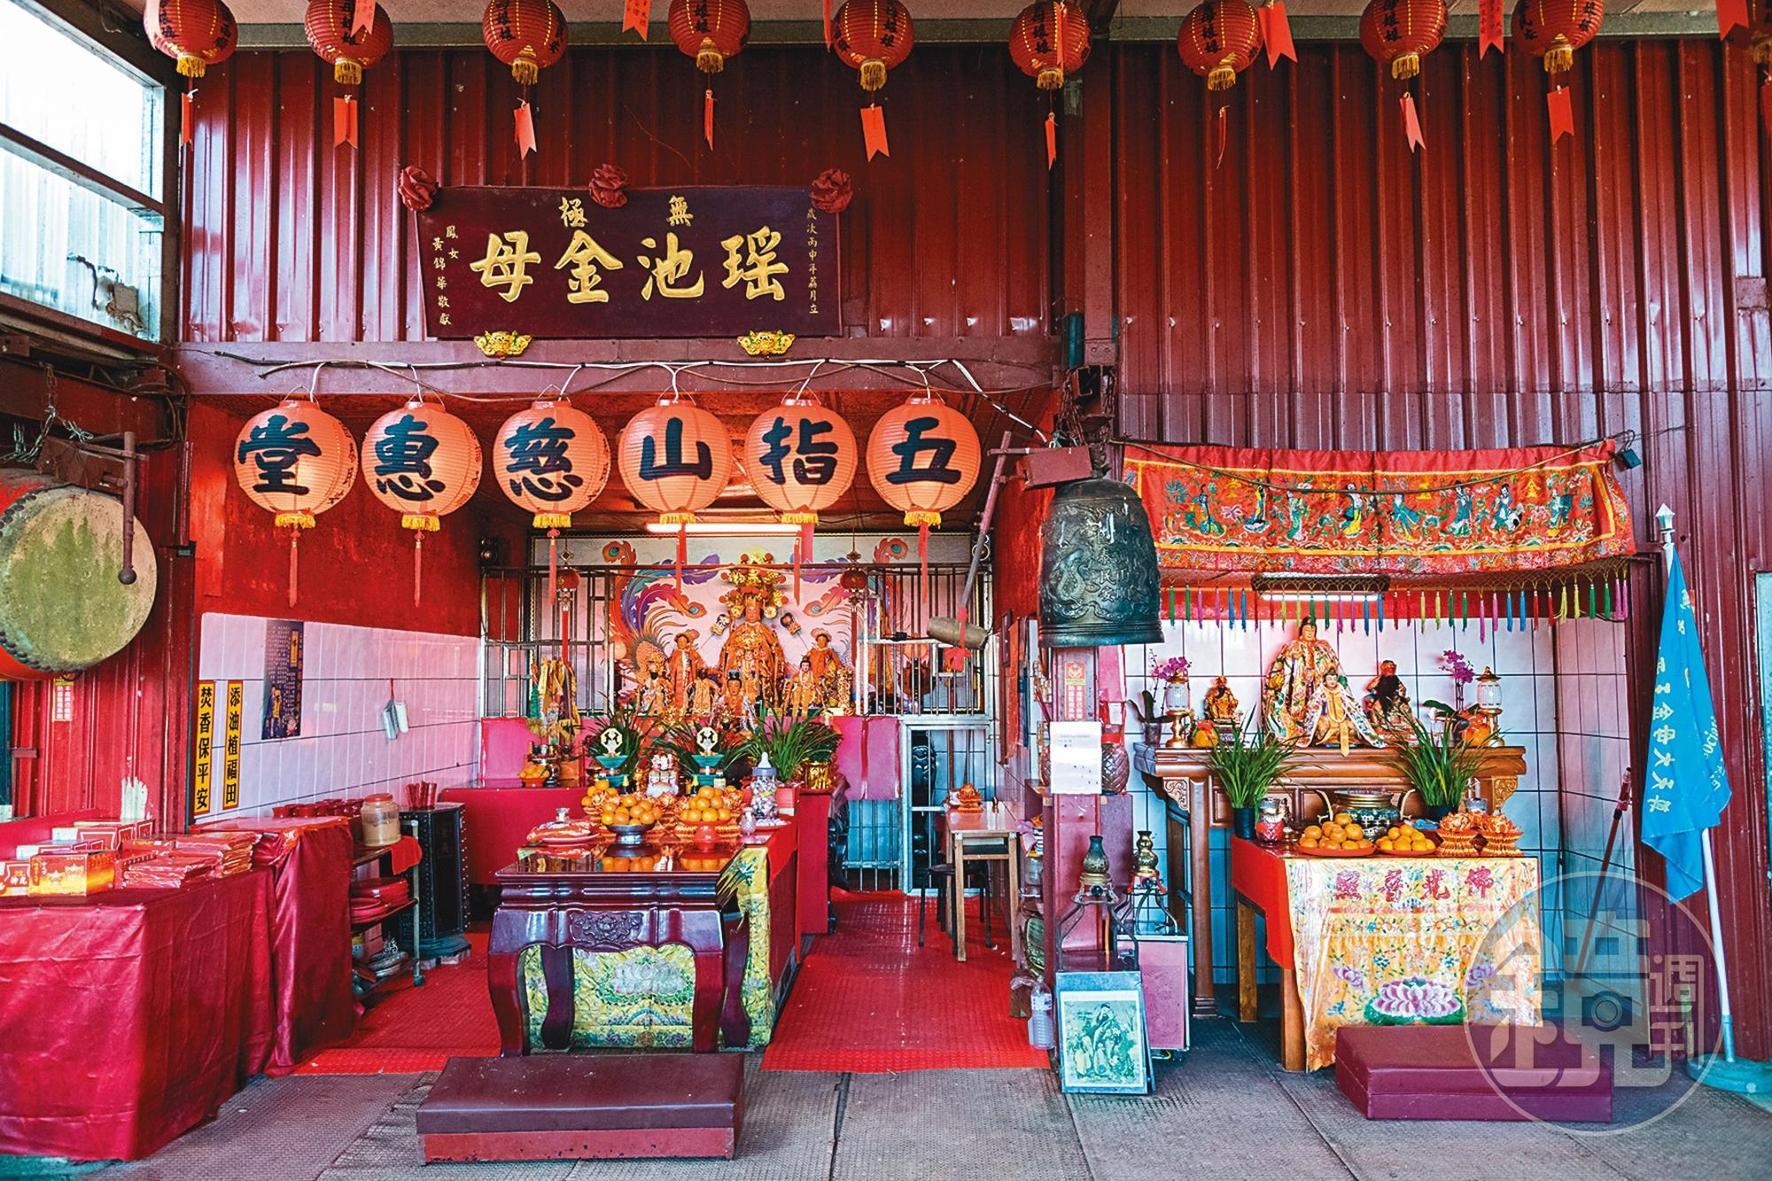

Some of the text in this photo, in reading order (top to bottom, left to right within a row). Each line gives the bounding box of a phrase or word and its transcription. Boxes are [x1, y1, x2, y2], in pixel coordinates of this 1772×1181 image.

[196, 686, 213, 810] 焚香保平安
[226, 687, 241, 804] 添油植福田
